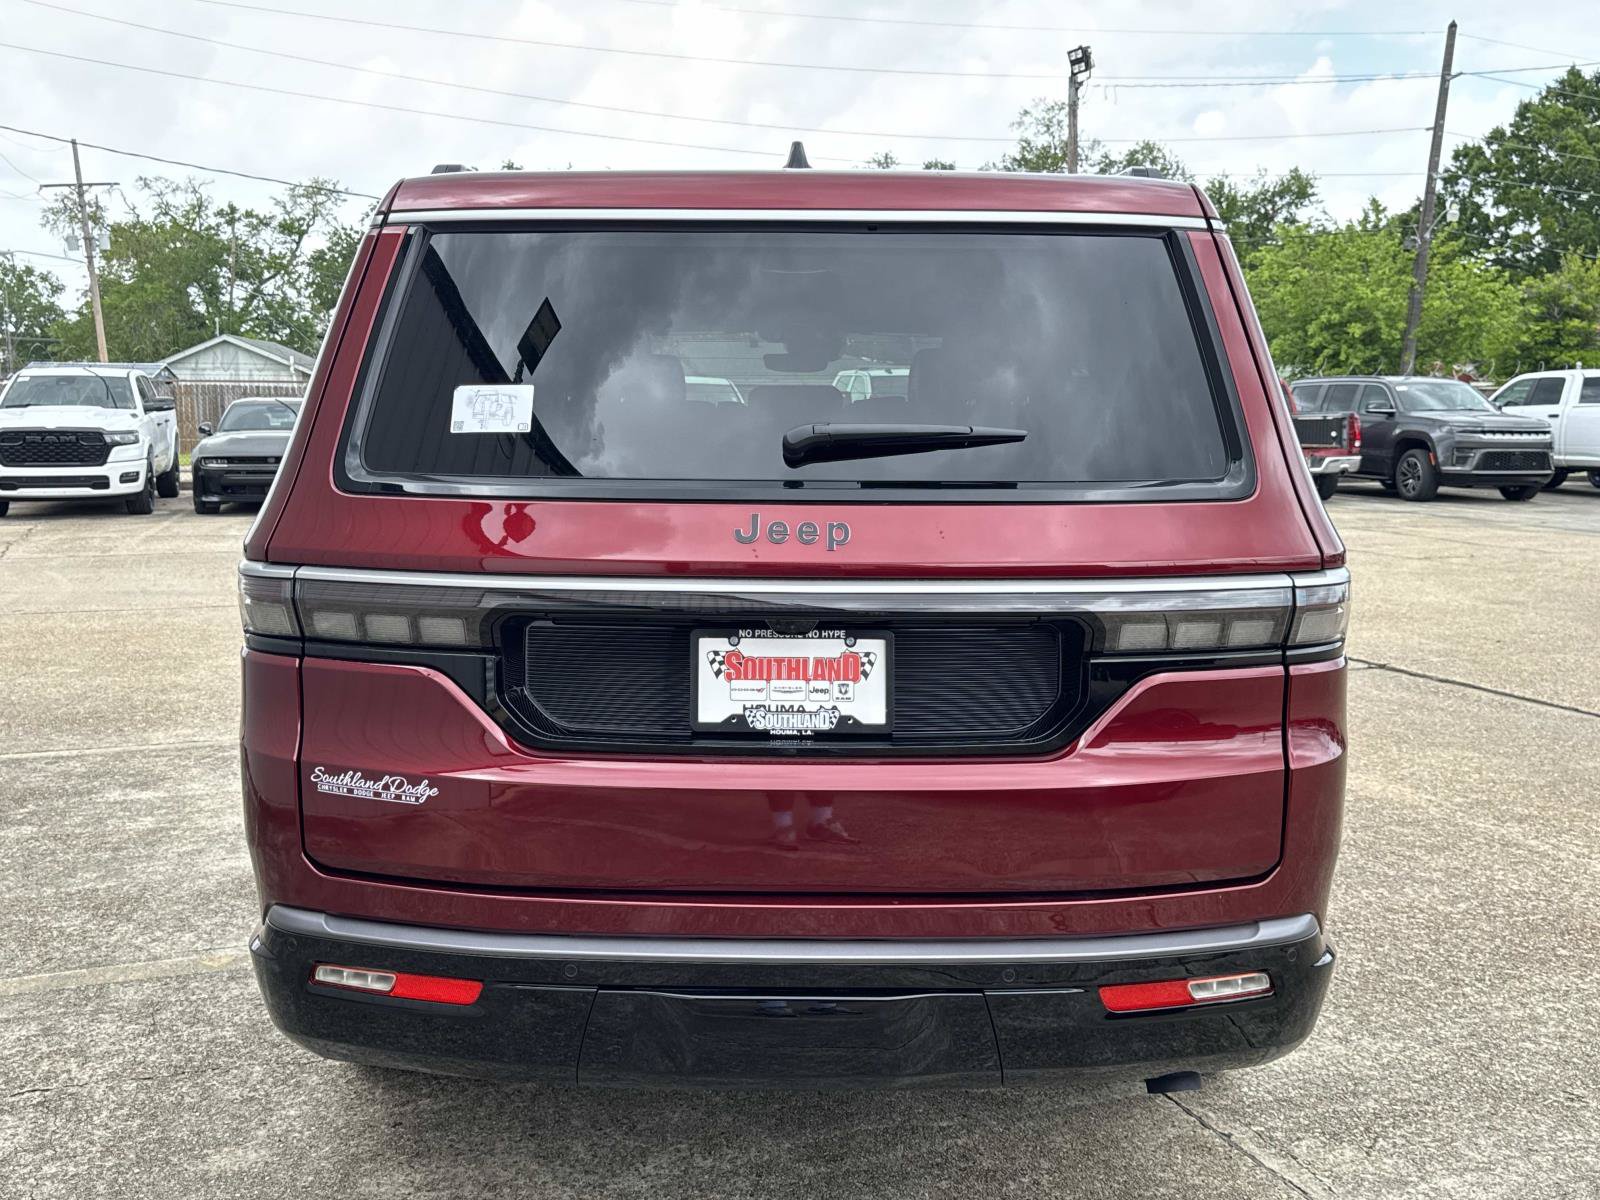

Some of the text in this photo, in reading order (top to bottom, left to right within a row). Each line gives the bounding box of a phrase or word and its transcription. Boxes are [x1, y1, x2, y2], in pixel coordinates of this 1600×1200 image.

[25, 435, 77, 443] RAM
[733, 512, 851, 551] Jeep
[739, 629, 753, 638] NO
[821, 630, 847, 638] HYPE
[724, 651, 861, 682] SOUTHLAND
[809, 686, 830, 695] Jeep
[755, 709, 830, 729] SOUTHLAND
[310, 766, 440, 804] Southland Dodge
[317, 784, 349, 794] CHRYSLER
[353, 789, 374, 798] DODGE
[401, 794, 416, 802] RAM
